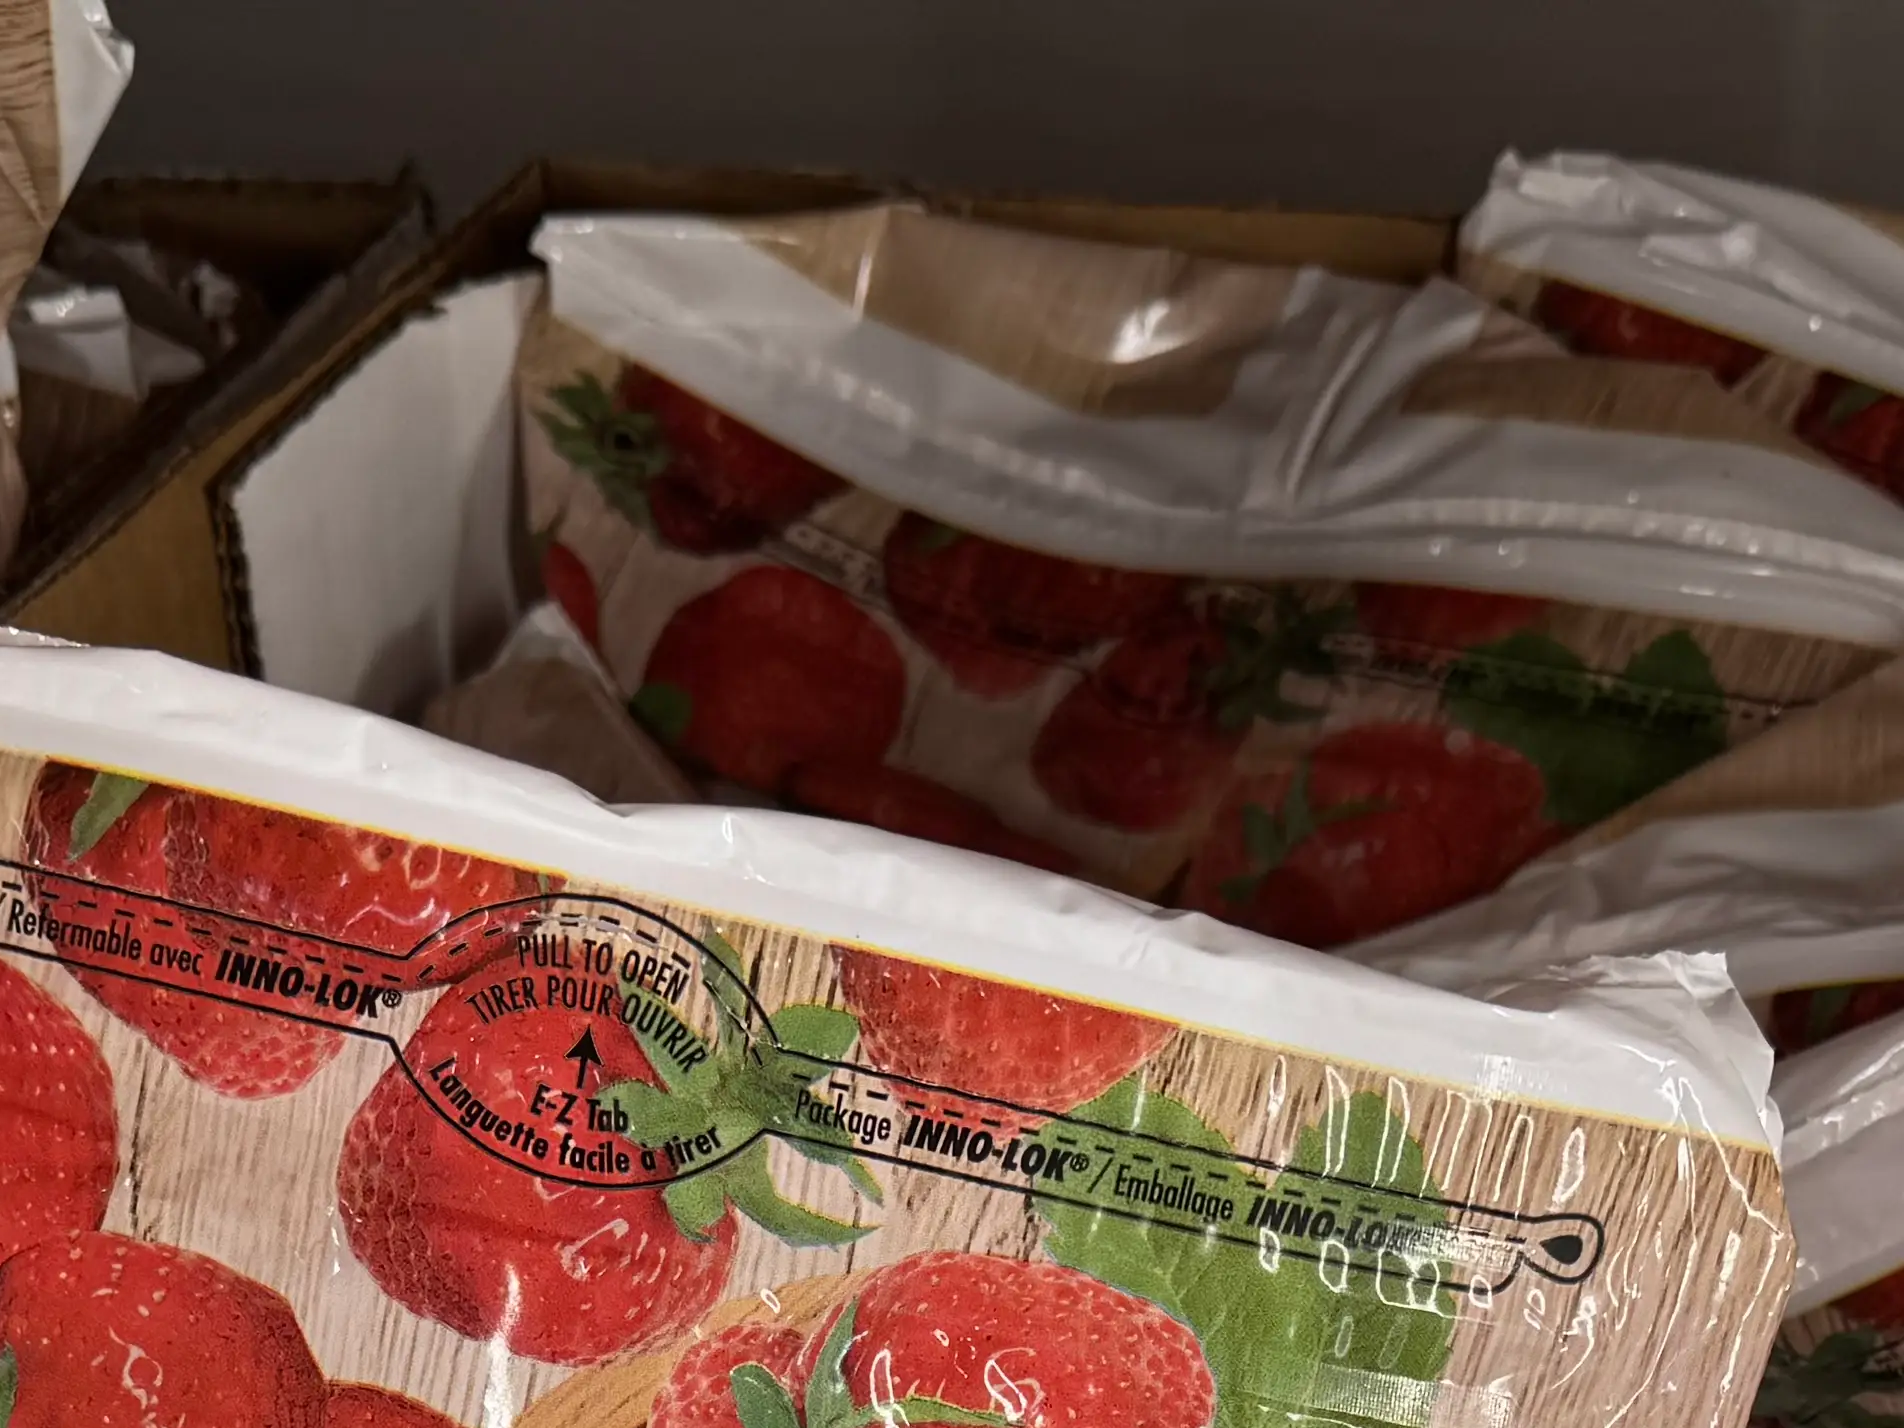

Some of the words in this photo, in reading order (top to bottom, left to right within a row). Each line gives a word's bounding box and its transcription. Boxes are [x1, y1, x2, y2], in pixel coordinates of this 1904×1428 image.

[6, 898, 143, 962] Refermable
[148, 943, 203, 977] avec
[516, 934, 574, 970] PULL
[583, 938, 613, 976] TO
[620, 946, 691, 1005] OPEN
[464, 974, 539, 1025] TIRER
[546, 974, 615, 1017] POUR
[620, 993, 710, 1075] OUVRIR
[428, 1056, 549, 1160] Languette
[558, 1133, 631, 1175] facile
[665, 1125, 724, 1167] tirer
[529, 1081, 577, 1127] E-Z
[583, 1094, 630, 1135] Tab
[796, 1085, 892, 1147] Package
[1114, 1163, 1235, 1221] Emballage
